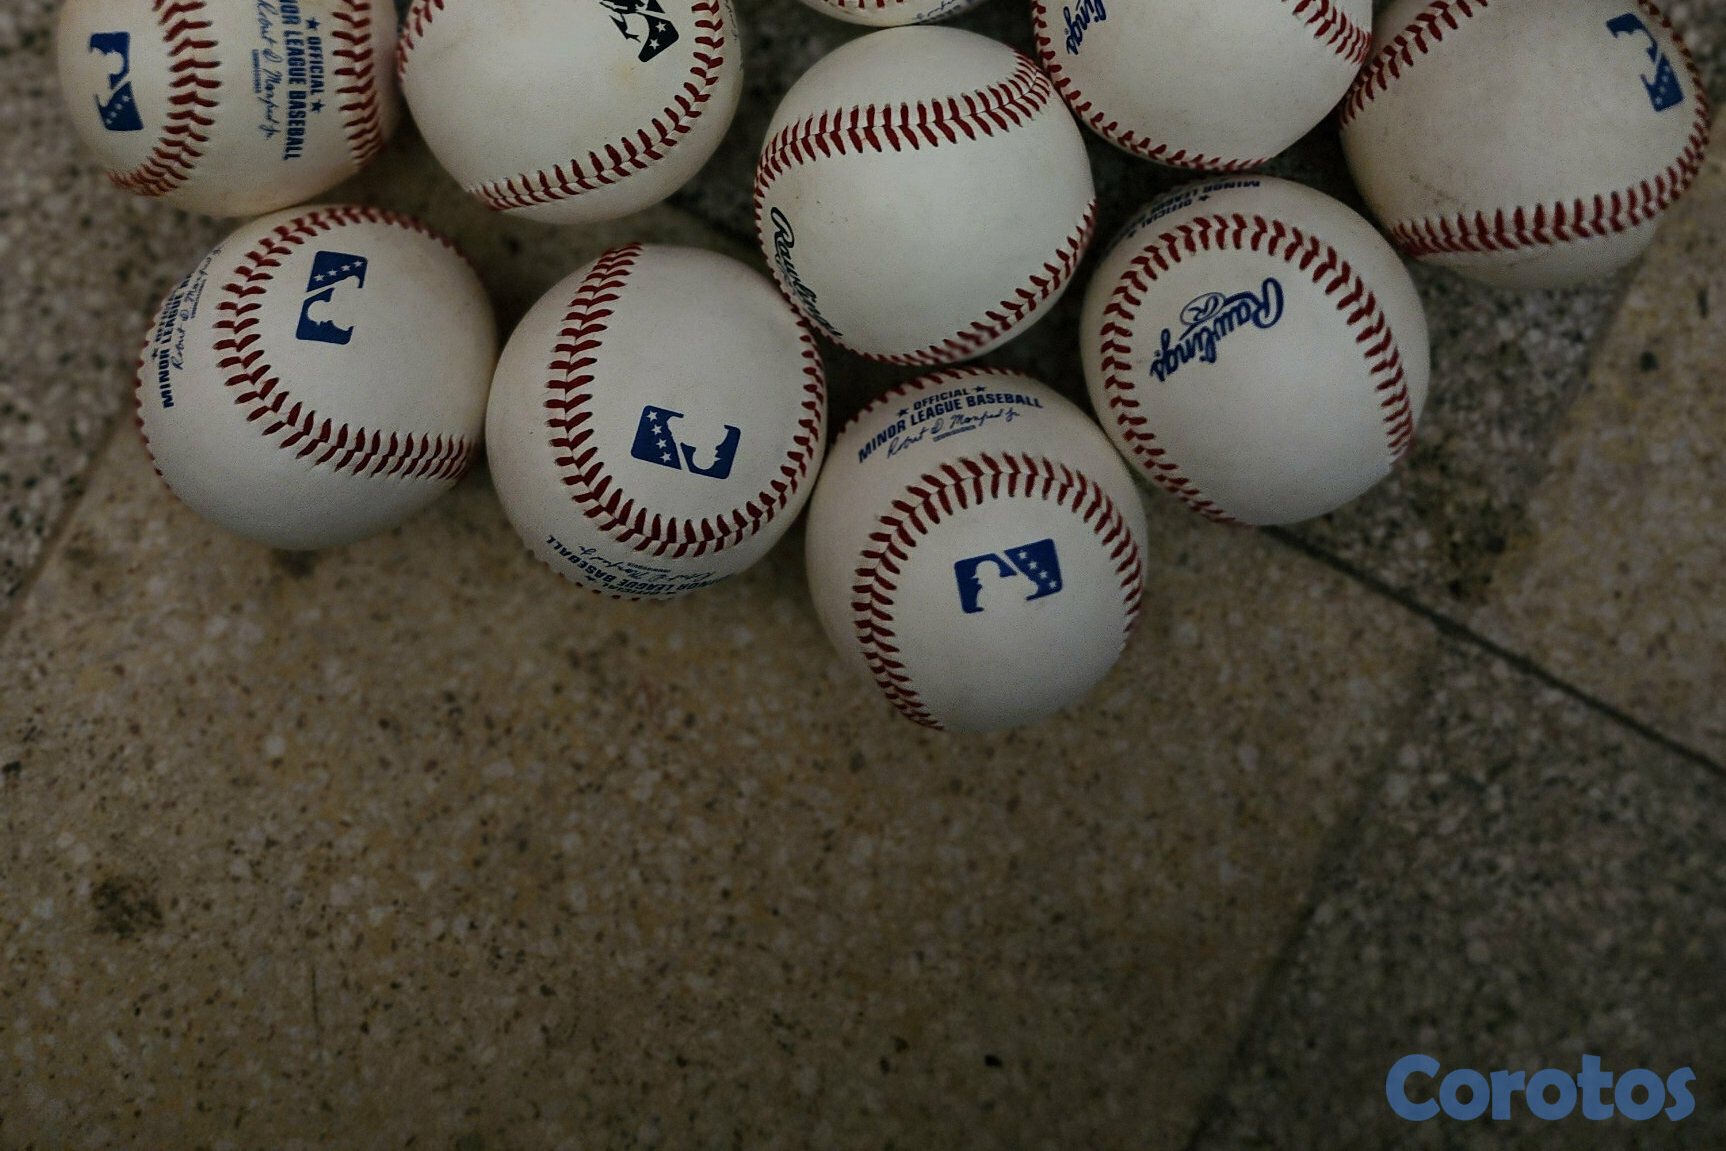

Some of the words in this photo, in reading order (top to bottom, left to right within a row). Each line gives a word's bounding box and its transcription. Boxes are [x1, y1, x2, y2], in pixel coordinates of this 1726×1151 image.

[282, 30, 306, 85] LEAGUE
[307, 36, 325, 96] OFFICIAL
[282, 90, 307, 161] BASEBALL
[1142, 198, 1193, 227] OFFICIAL
[1203, 180, 1260, 194] MINOR
[161, 291, 185, 346] LEAGUE
[1150, 277, 1284, 382] Rawlings
[158, 348, 175, 409] MINOR
[913, 387, 971, 411] OFFICIAL
[858, 419, 907, 464] MINOR
[910, 398, 963, 426] LEAGUE
[966, 392, 1044, 409] BASEBALL
[546, 535, 617, 582] BASEBALL
[620, 578, 676, 593] LEAGUE
